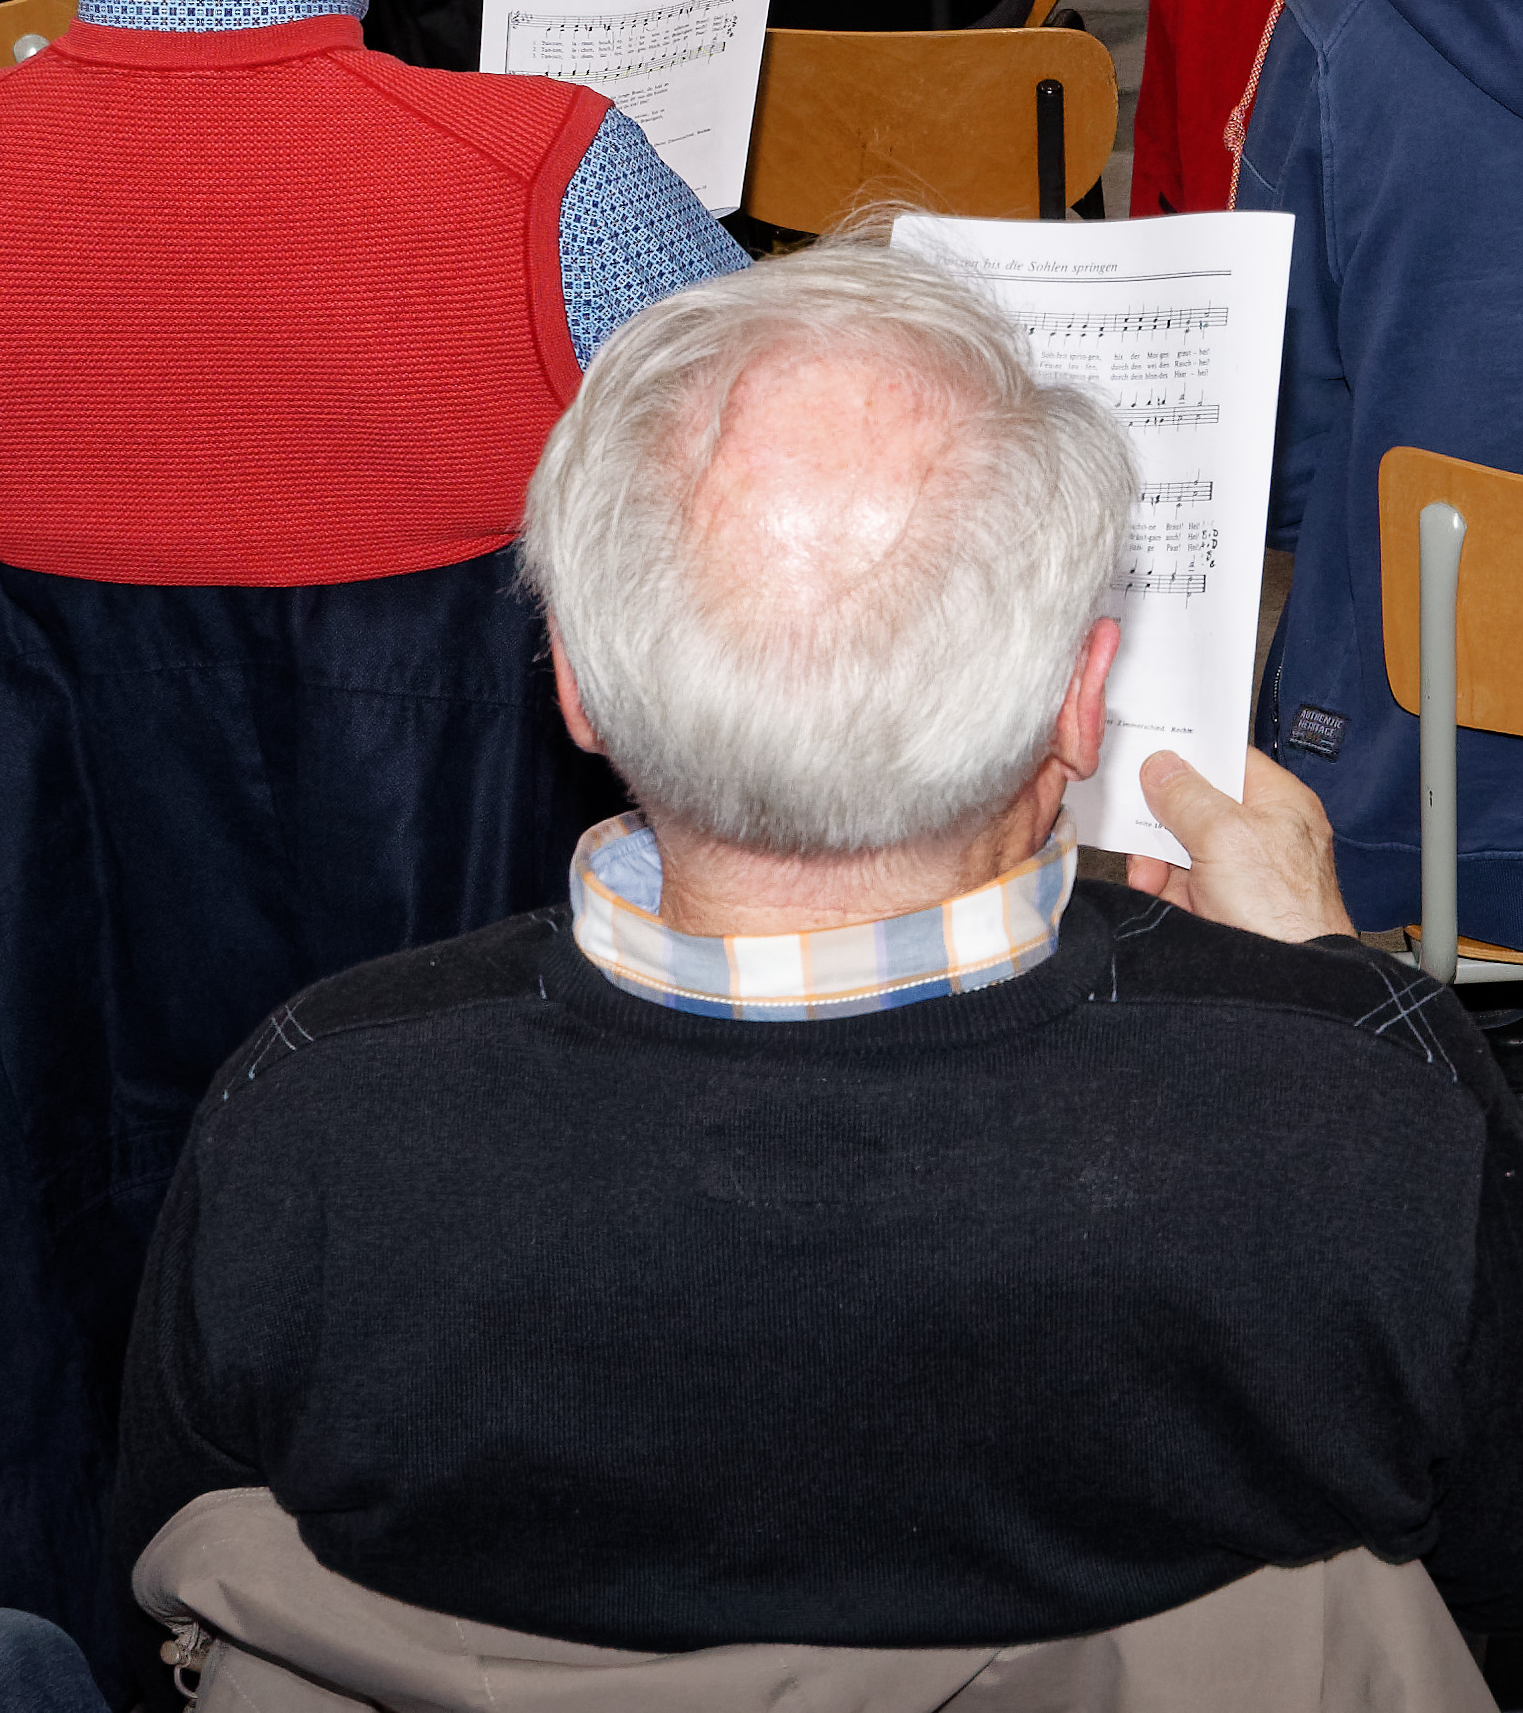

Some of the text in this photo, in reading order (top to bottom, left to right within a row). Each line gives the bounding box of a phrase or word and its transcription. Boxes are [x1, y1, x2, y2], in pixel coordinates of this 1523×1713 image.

[984, 259, 999, 270] bis
[1006, 260, 1023, 270] die
[1028, 262, 1067, 272] Sohlen
[1072, 263, 1117, 275] springen
